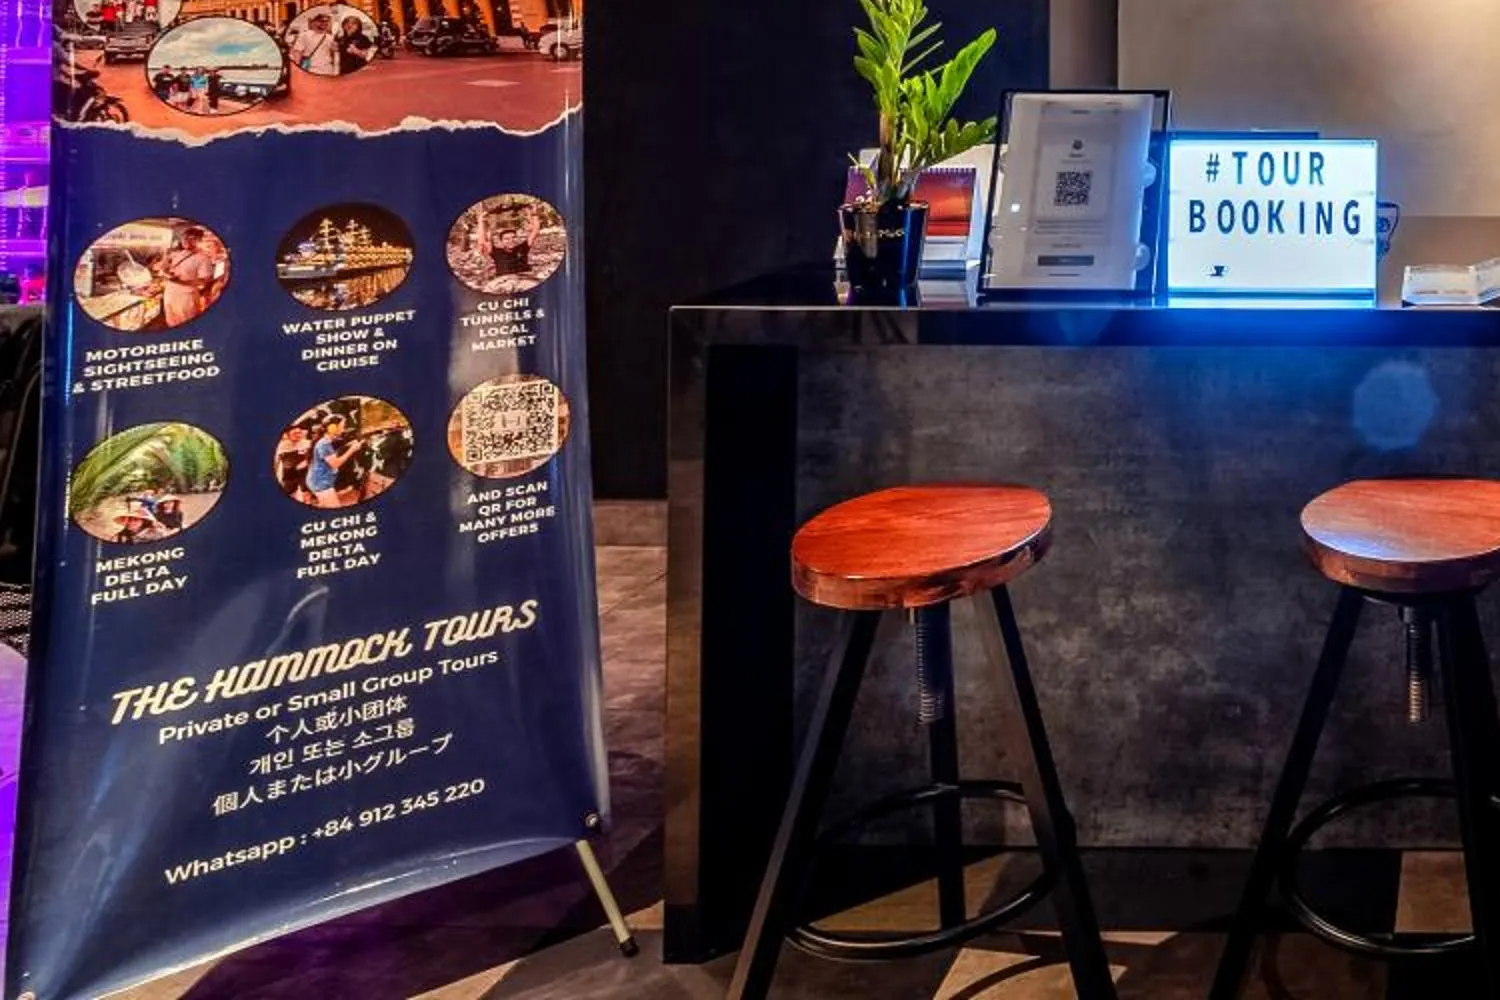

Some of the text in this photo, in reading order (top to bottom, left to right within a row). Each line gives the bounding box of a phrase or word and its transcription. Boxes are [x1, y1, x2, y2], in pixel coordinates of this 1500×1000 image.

[1189, 199, 1361, 236] BOOKING
[460, 308, 545, 327] TUNNELS &
[477, 298, 529, 312] CU CHI
[282, 310, 417, 335] WATER PUPPET
[479, 323, 529, 338] LOCAL
[316, 327, 385, 345] SHOW &
[471, 335, 537, 352] MARKET
[85, 338, 205, 362] MOTORBIKE
[301, 339, 398, 361] DINNER ON
[83, 352, 216, 378] SIGHTSEEING
[316, 355, 380, 372] CRUISE
[72, 365, 221, 395] & STREETFOOD
[467, 480, 548, 505] AND SCAN
[478, 495, 537, 516] QR FOR
[301, 511, 377, 534] CU CHI &
[459, 505, 555, 533] MANY MORE
[300, 525, 378, 549] MEKONG
[477, 522, 539, 543] OFFERS
[96, 547, 185, 573] MEKONG
[308, 543, 365, 562] DELTA
[104, 565, 171, 587] DELTA
[296, 552, 381, 579] FULL DAY
[91, 575, 188, 606] FULL DAY
[111, 599, 538, 725] THE HAMMOCK TOURS
[159, 650, 499, 744] Private or Small Group Tours
[265, 694, 409, 745] 个人或小团体
[249, 747, 294, 775] 개인
[302, 739, 345, 763] 또는
[212, 732, 454, 817] 個人または小グループ
[164, 834, 296, 885] Whatsapp
[311, 816, 355, 839] +84
[359, 803, 396, 828] 912
[401, 790, 440, 816] 345
[444, 777, 486, 803] 220
